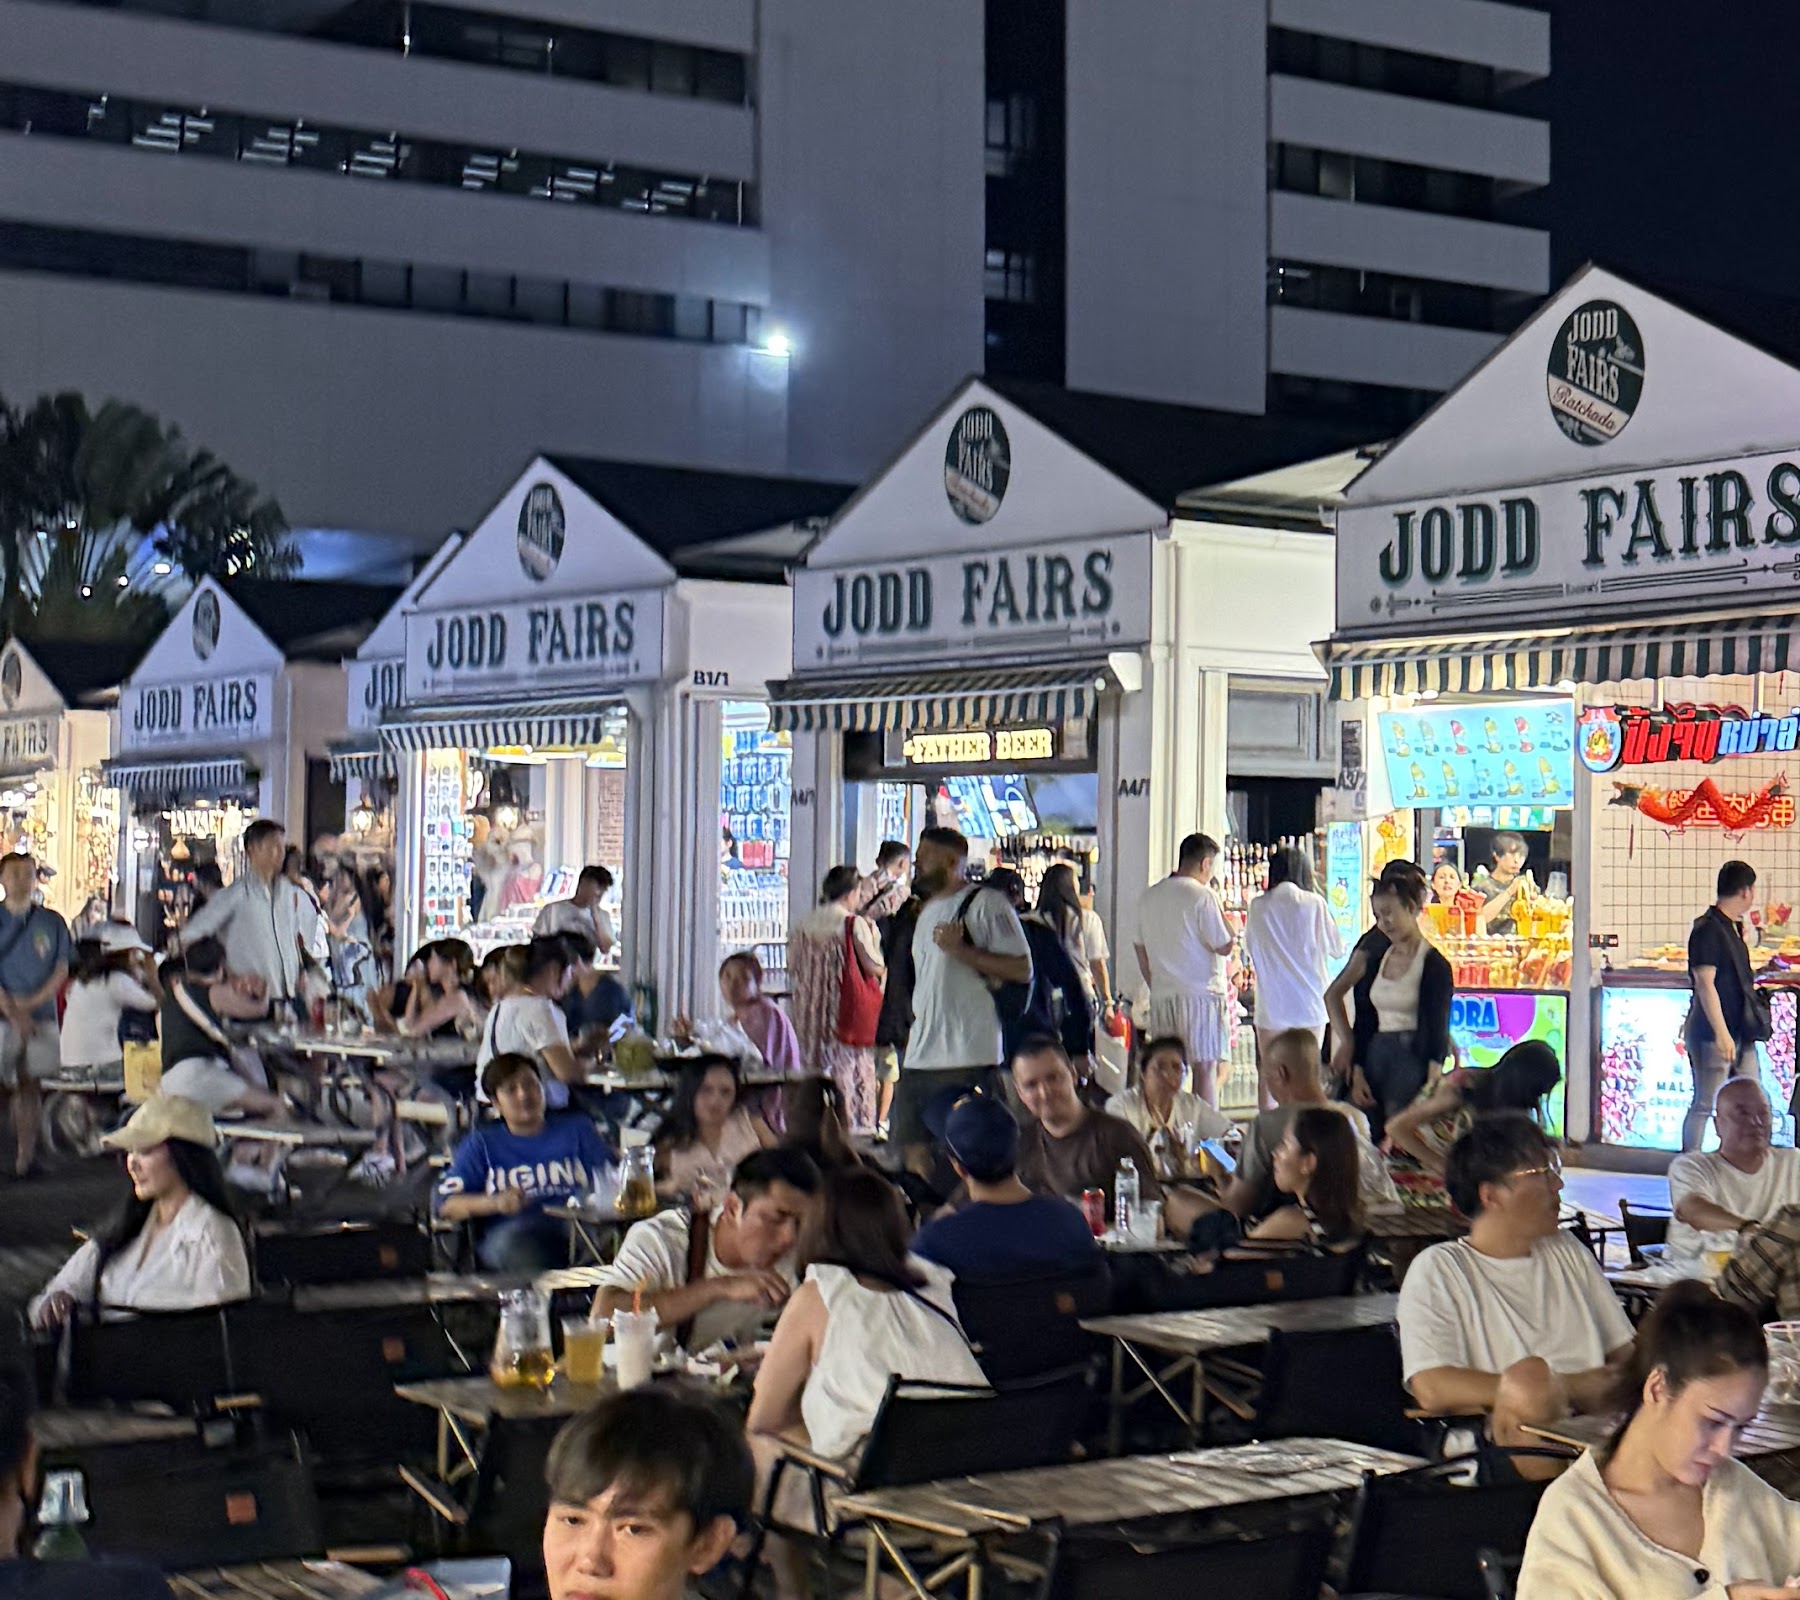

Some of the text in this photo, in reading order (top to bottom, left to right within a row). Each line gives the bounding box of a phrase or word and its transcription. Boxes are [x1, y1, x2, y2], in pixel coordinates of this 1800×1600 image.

[1567, 308, 1619, 344] JODD
[1566, 344, 1620, 405] FAIRS
[1553, 384, 1617, 431] Ratchada
[1379, 497, 1541, 585] JODD
[822, 551, 1113, 638] JODD FAIRS
[426, 601, 636, 670] JODD FAIRS
[364, 662, 405, 709] JO
[693, 670, 729, 687] B1/1
[133, 679, 258, 732] JODD FAIRS
[912, 728, 1053, 764] FATHER BEER
